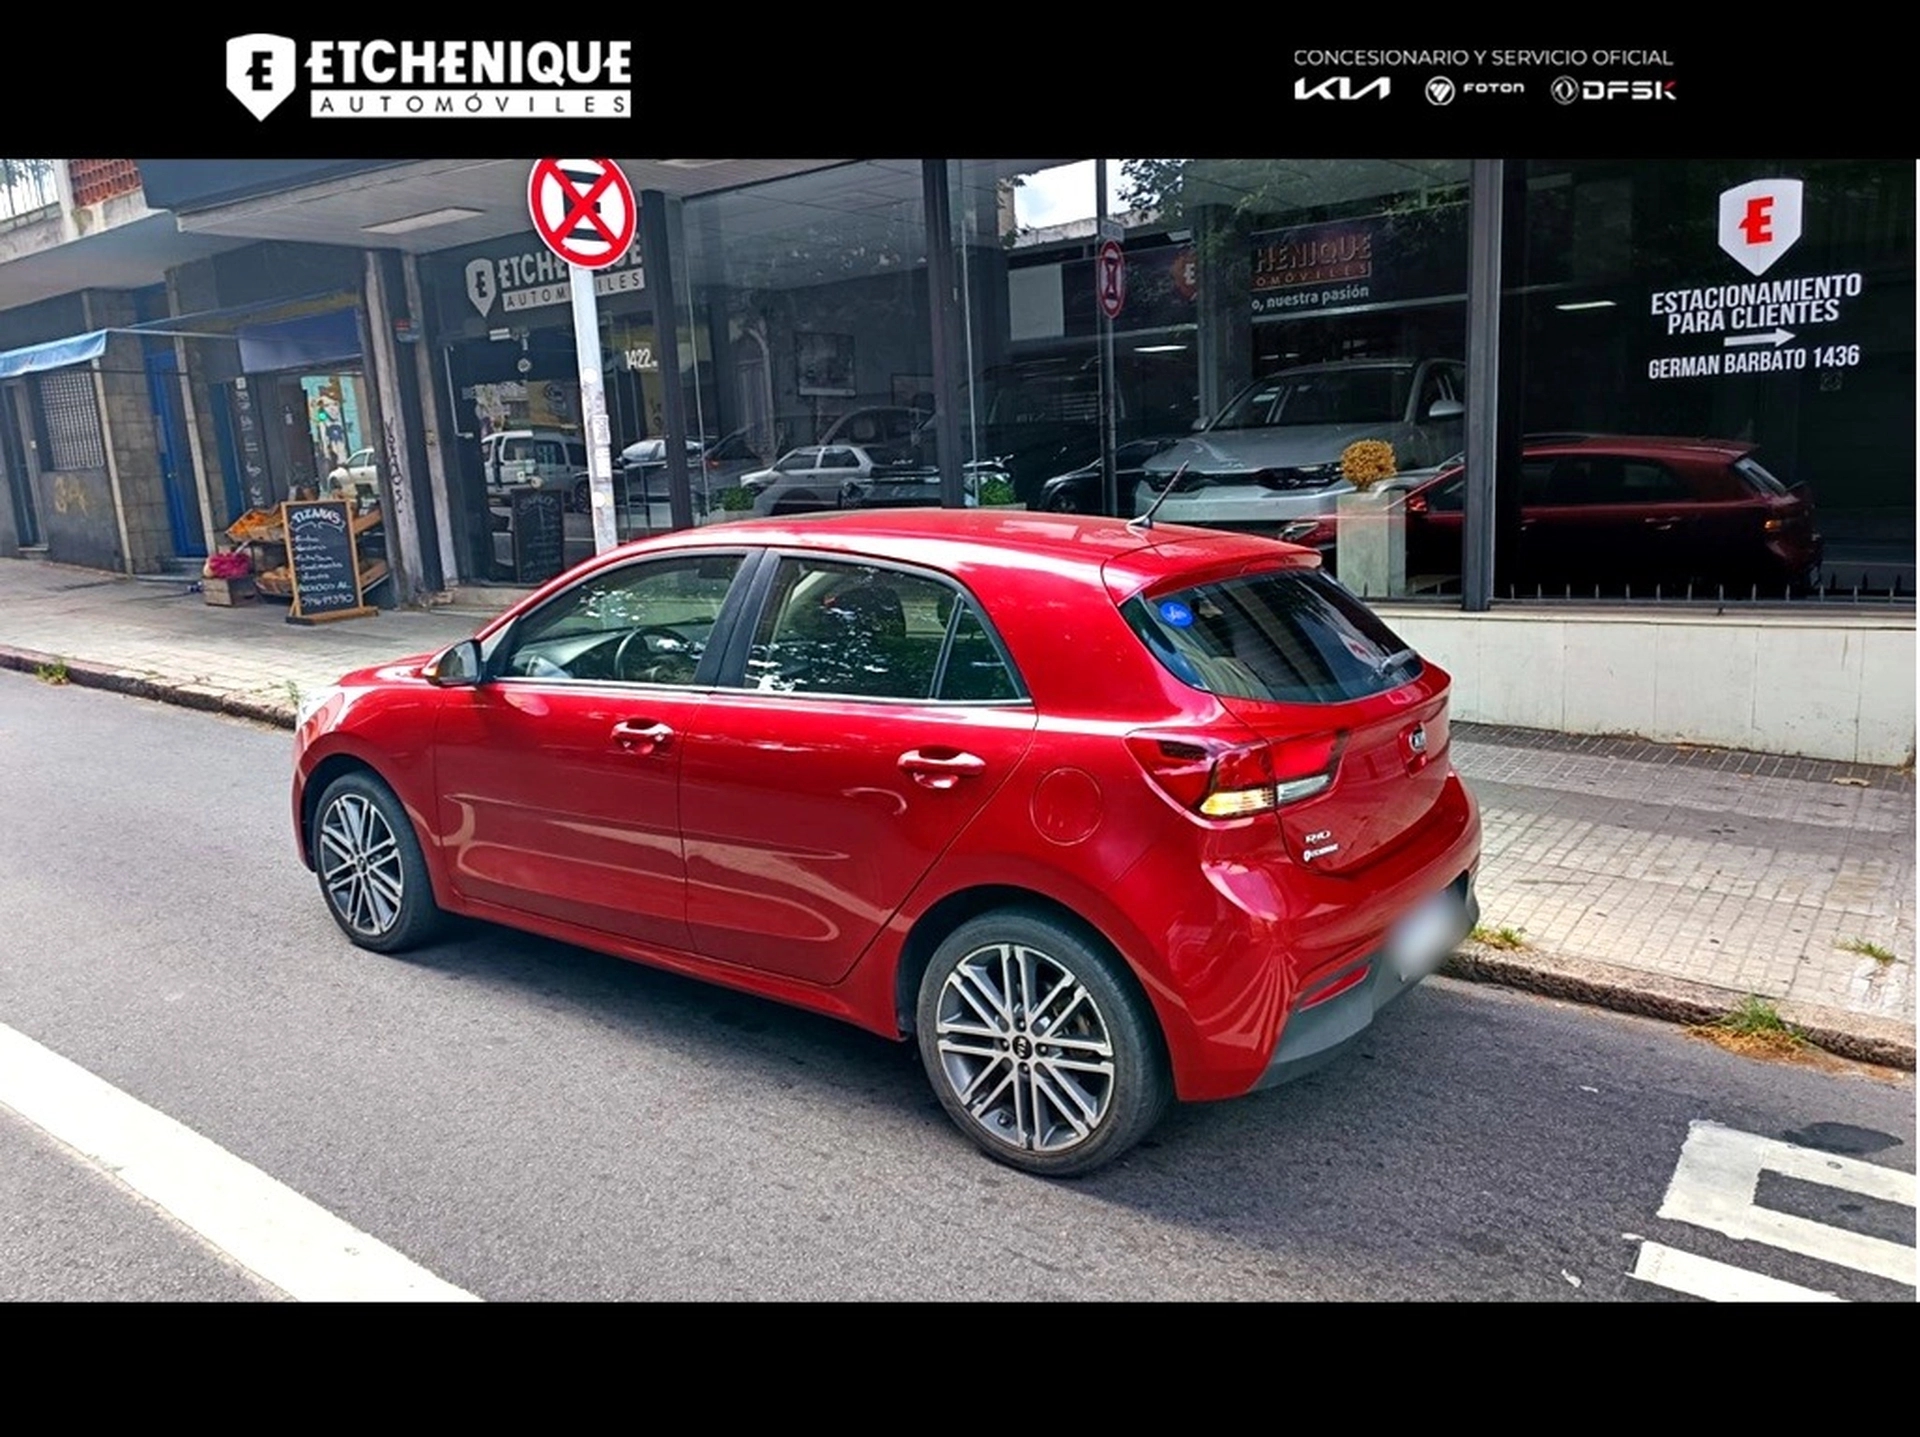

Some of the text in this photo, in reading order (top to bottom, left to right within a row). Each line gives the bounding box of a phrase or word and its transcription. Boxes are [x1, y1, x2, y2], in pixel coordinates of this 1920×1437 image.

[1255, 232, 1373, 274] HENIQUE
[506, 272, 641, 308] AUTOMILES
[1255, 265, 1367, 288] OMÓVILES
[1651, 273, 1862, 315] ESTACIONAMIENTO
[1266, 290, 1319, 308] nuestra
[1321, 284, 1370, 306] pasión
[1667, 298, 1840, 335] PARA CLIENTES
[624, 347, 652, 370] 1422
[1648, 344, 1861, 379] GERMAN BARBATO 1436
